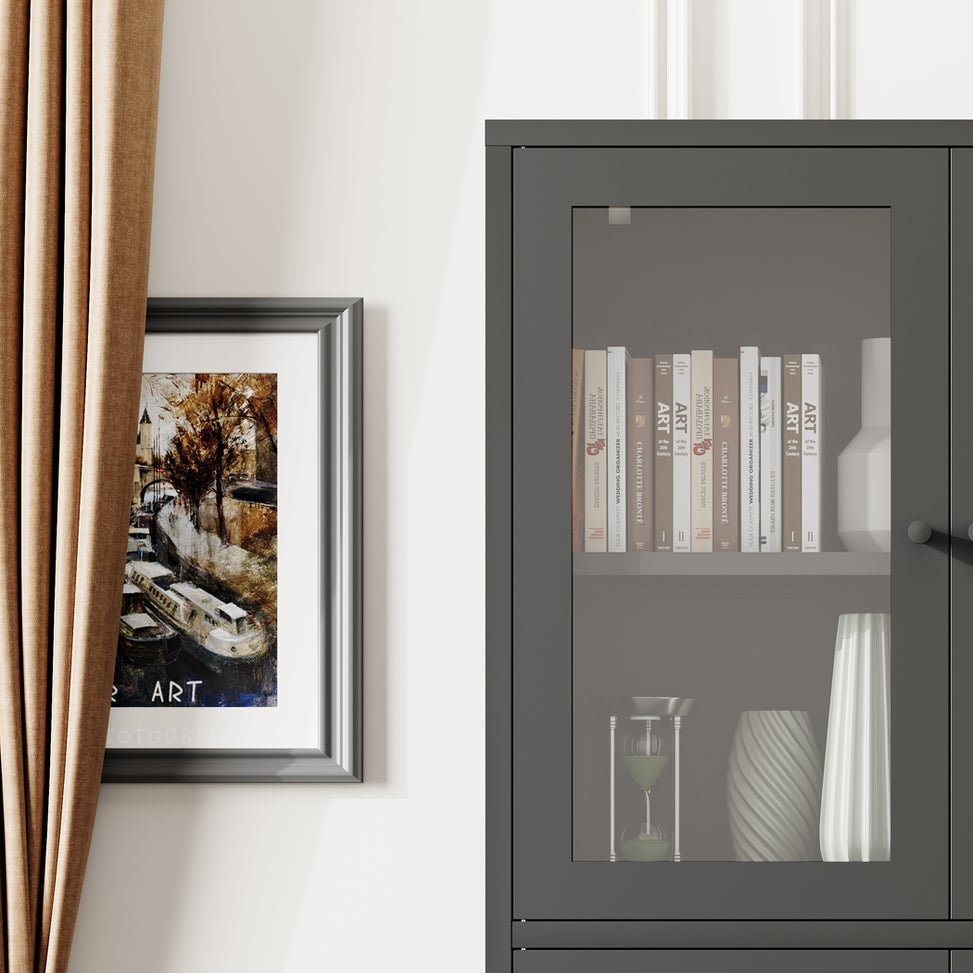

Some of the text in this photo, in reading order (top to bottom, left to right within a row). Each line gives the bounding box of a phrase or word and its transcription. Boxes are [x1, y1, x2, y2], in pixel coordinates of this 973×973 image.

[657, 401, 671, 434] ART
[675, 402, 688, 434] ART
[786, 401, 800, 434] ART
[804, 402, 817, 434] ART
[636, 441, 644, 489] CHARLOTTE
[151, 680, 203, 703] ART
